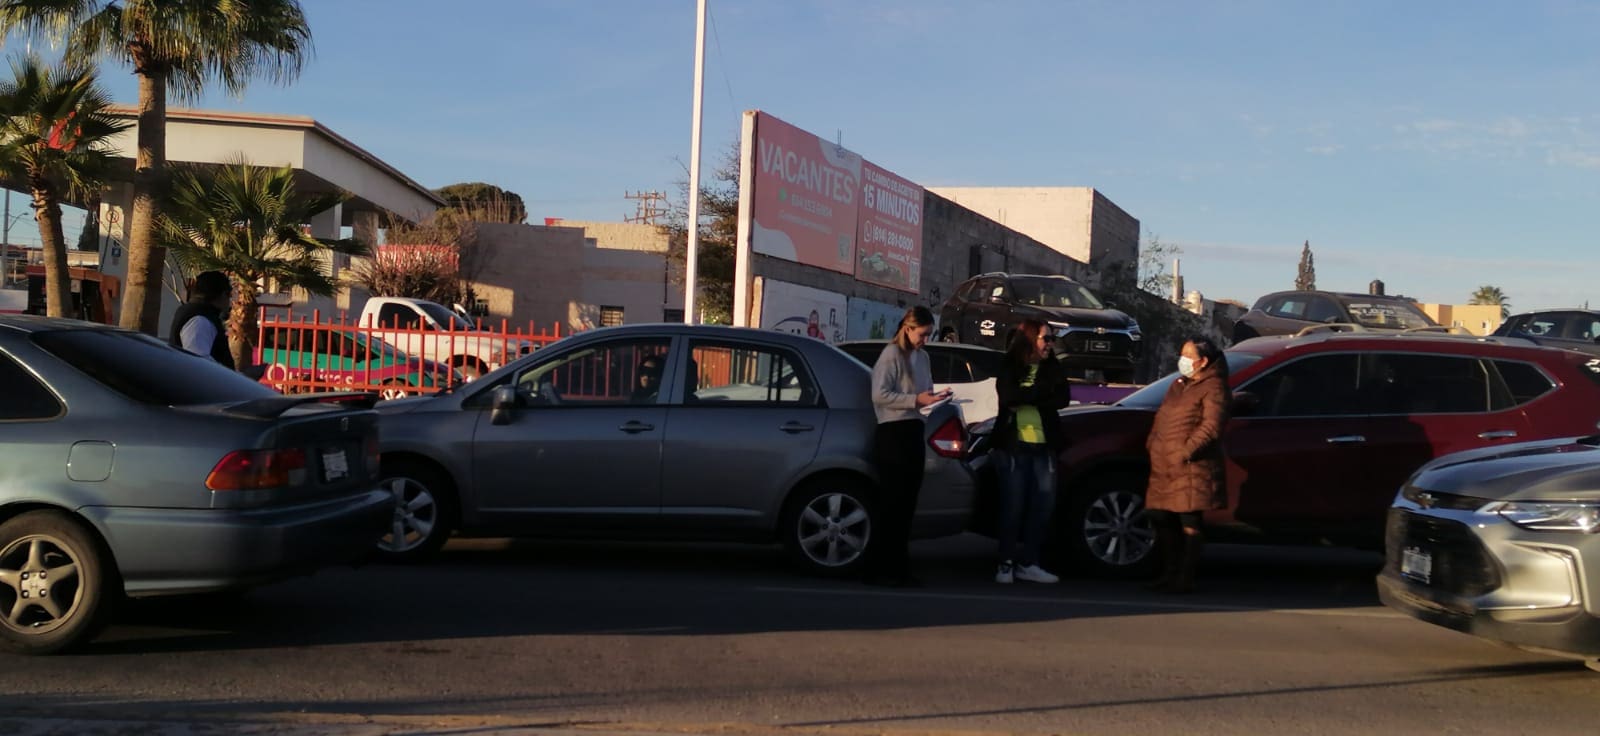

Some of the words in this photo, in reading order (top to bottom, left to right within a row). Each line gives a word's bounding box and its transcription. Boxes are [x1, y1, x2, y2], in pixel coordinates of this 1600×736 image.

[760, 138, 853, 205] VACANTES
[863, 183, 874, 208] 15
[876, 188, 919, 225] MINUTOS
